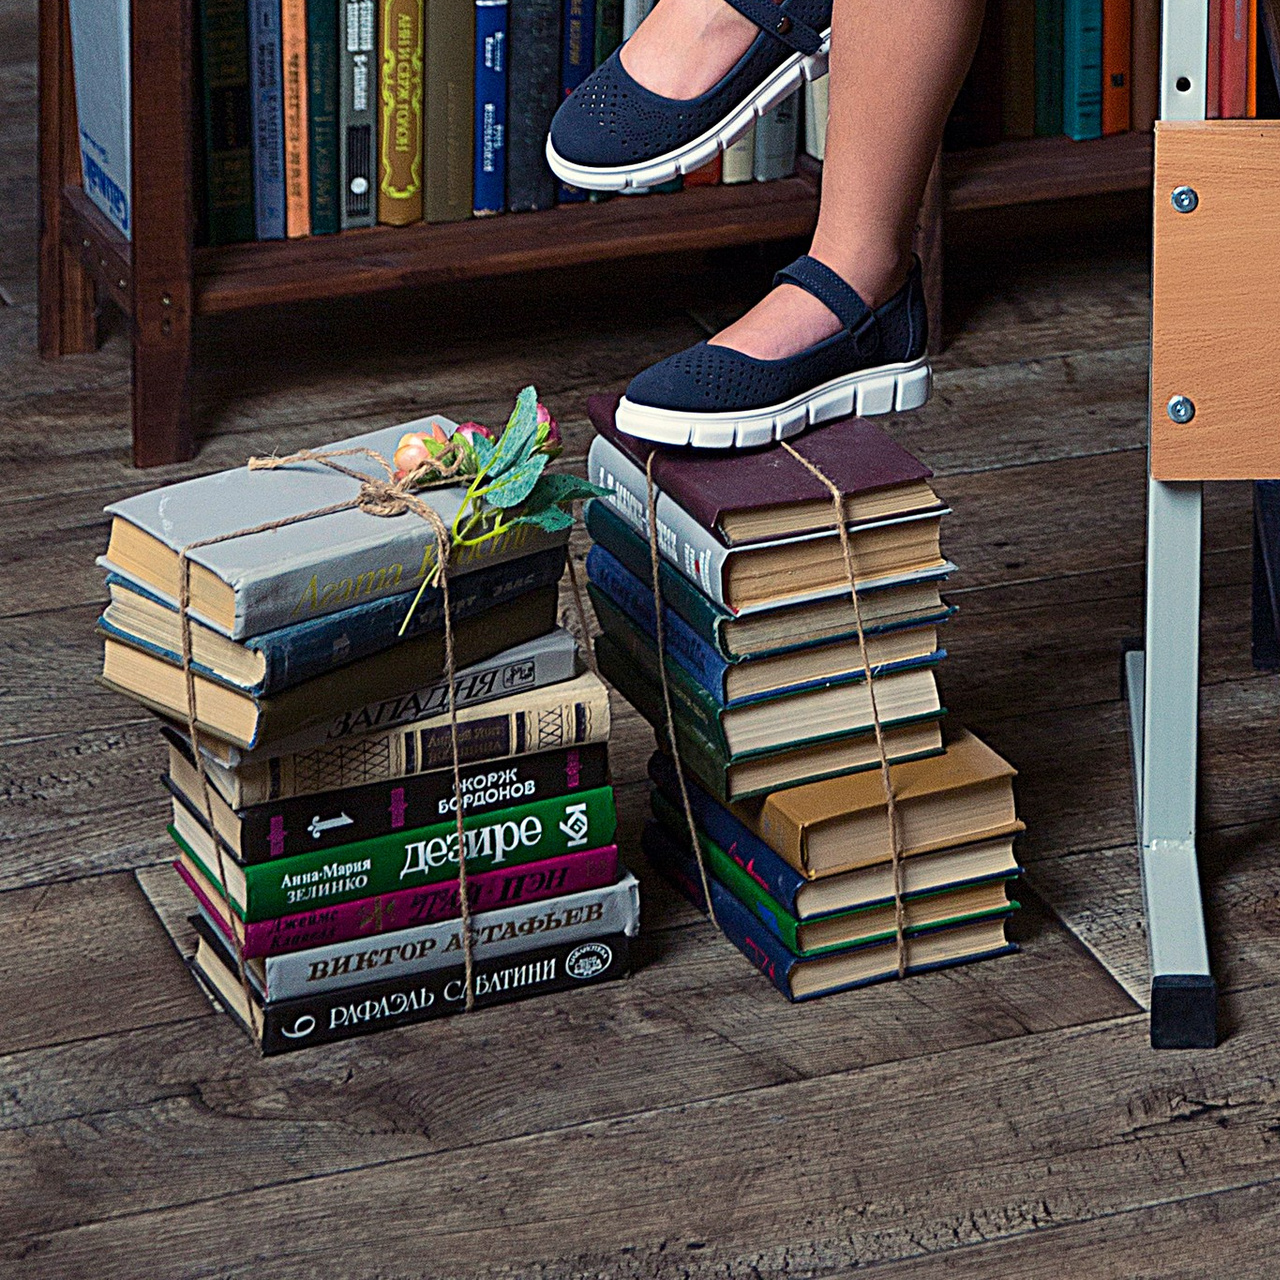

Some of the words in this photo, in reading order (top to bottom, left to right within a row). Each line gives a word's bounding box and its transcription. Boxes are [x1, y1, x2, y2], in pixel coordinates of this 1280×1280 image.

[292, 563, 404, 616] Агата
[327, 669, 500, 739] ЗАПАДНЯ
[438, 780, 536, 814] БОРДОНОВ
[286, 874, 369, 905] ЗЕЛИНКО
[305, 937, 437, 983] ВИКТОР
[328, 987, 435, 1029] РАФАЭЛЬ
[443, 957, 557, 1000] САБАТИНИ
